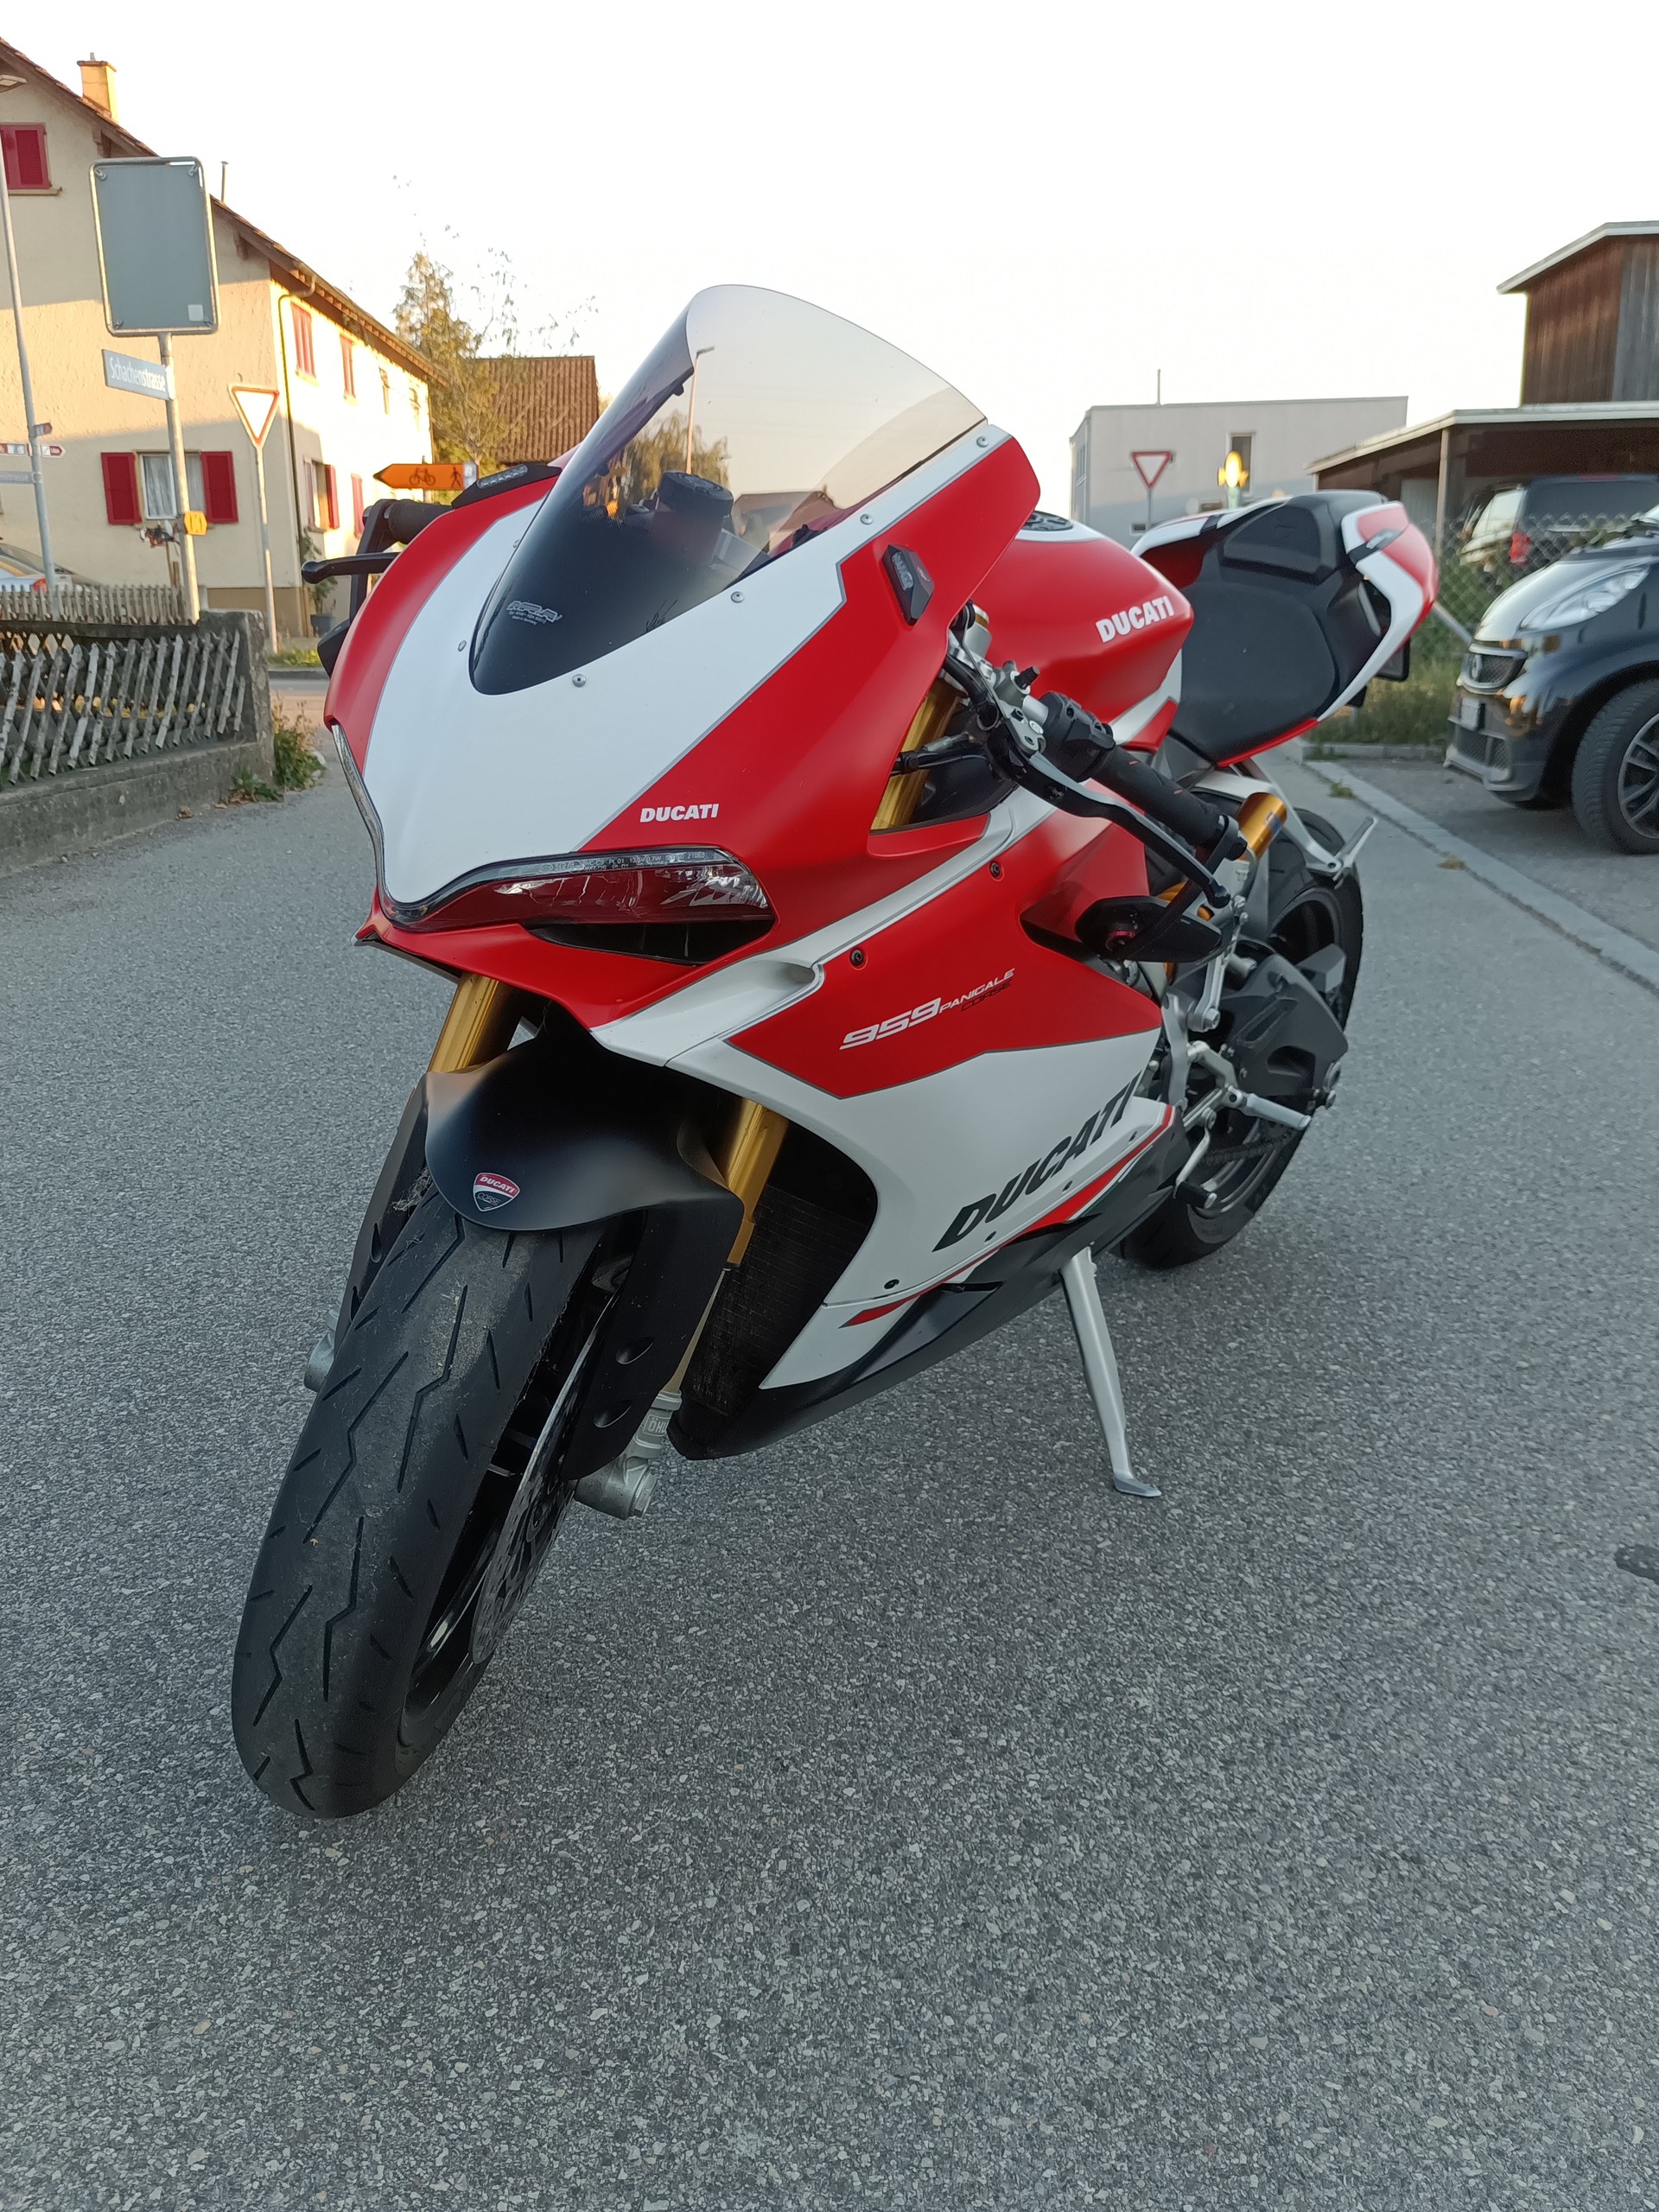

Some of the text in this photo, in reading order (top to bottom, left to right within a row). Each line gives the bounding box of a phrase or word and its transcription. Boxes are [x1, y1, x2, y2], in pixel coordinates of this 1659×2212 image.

[109, 357, 167, 392] Schachenstrasse
[1095, 595, 1175, 643] DUCATI
[639, 803, 720, 823] DUCATI
[839, 968, 1015, 1051] 959 PANIGALE
[961, 979, 1014, 1012] CORSE
[931, 1070, 1142, 1253] DUCATI
[480, 1176, 516, 1194] DUCATI
